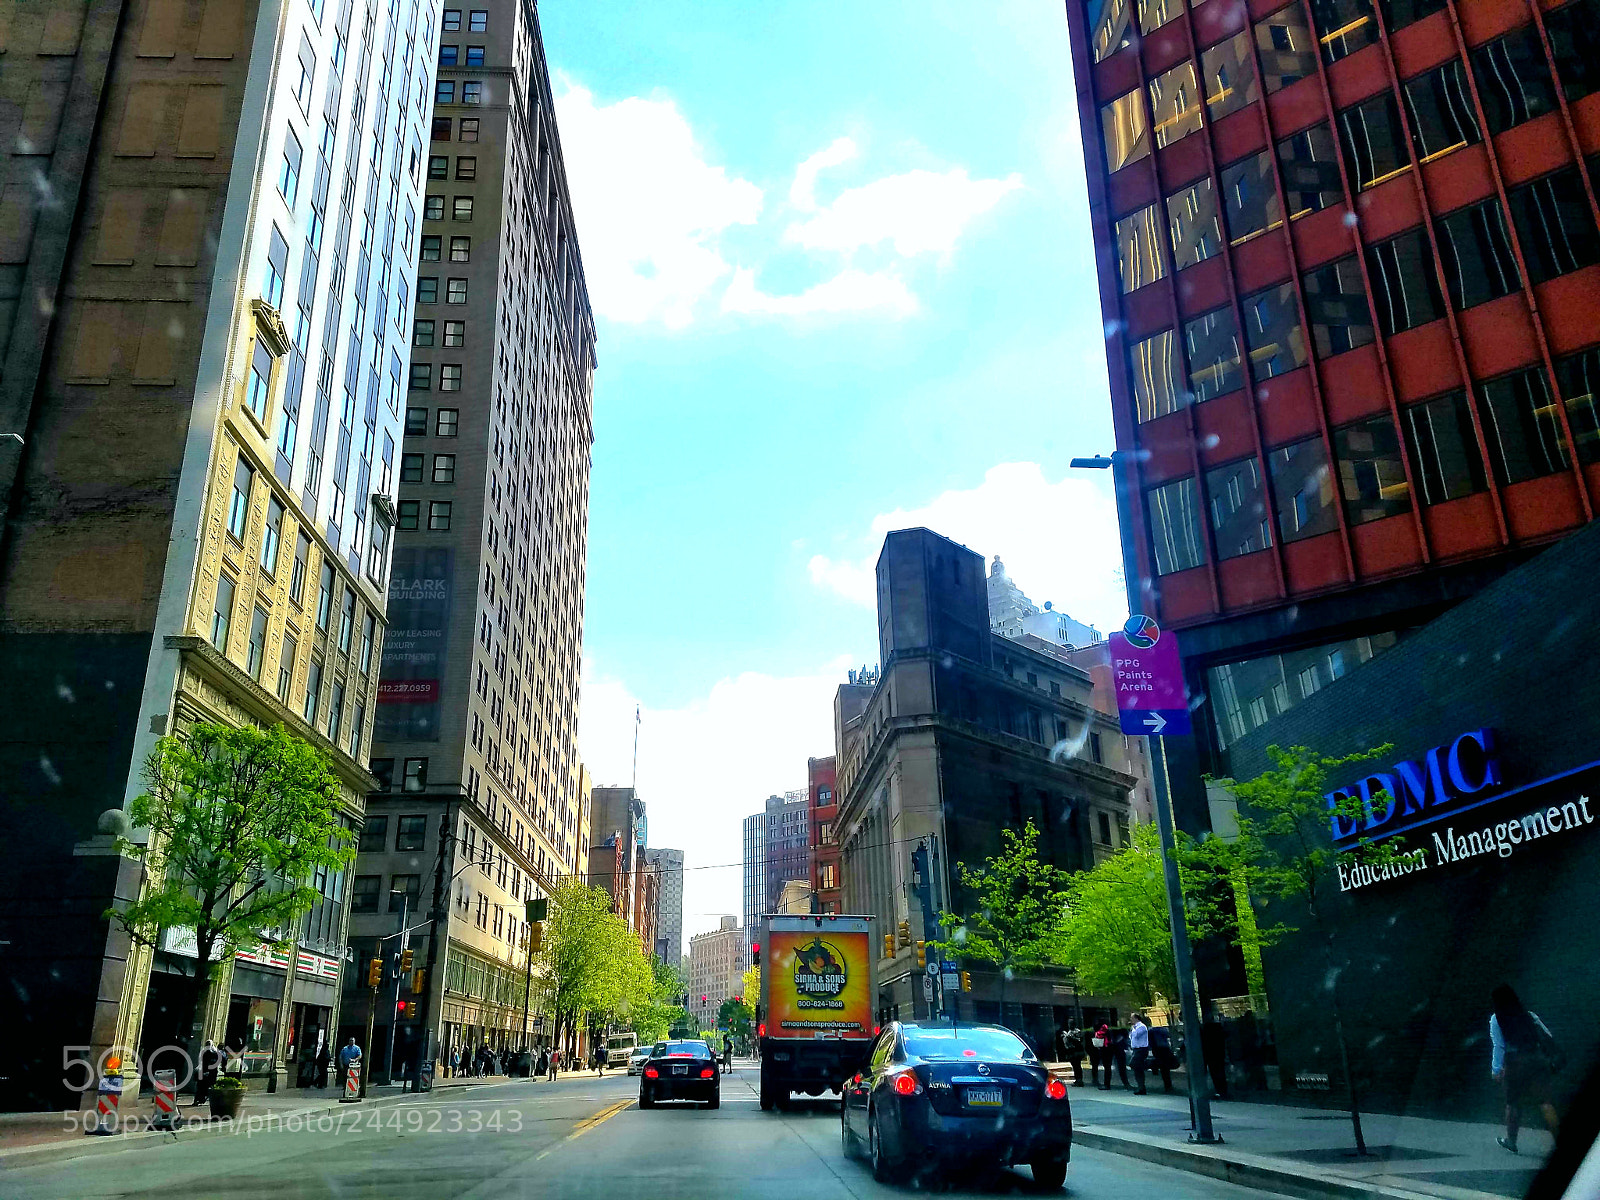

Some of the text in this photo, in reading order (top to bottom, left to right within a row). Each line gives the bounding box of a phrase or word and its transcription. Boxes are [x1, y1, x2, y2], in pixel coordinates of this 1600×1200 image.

[390, 579, 446, 590] CLARK
[389, 591, 446, 600] BUILDING
[406, 629, 442, 637] LEASING
[383, 641, 416, 649] LUXURY
[382, 653, 437, 661] APARTMENTS
[1116, 659, 1140, 668] PPG
[1117, 670, 1153, 679] Paints
[1120, 682, 1153, 691] Arena
[1323, 727, 1502, 842] EDMC
[1335, 794, 1595, 892] Education Management
[818, 975, 824, 983] &
[825, 974, 846, 984] SONS
[805, 982, 840, 992] PRODUCE
